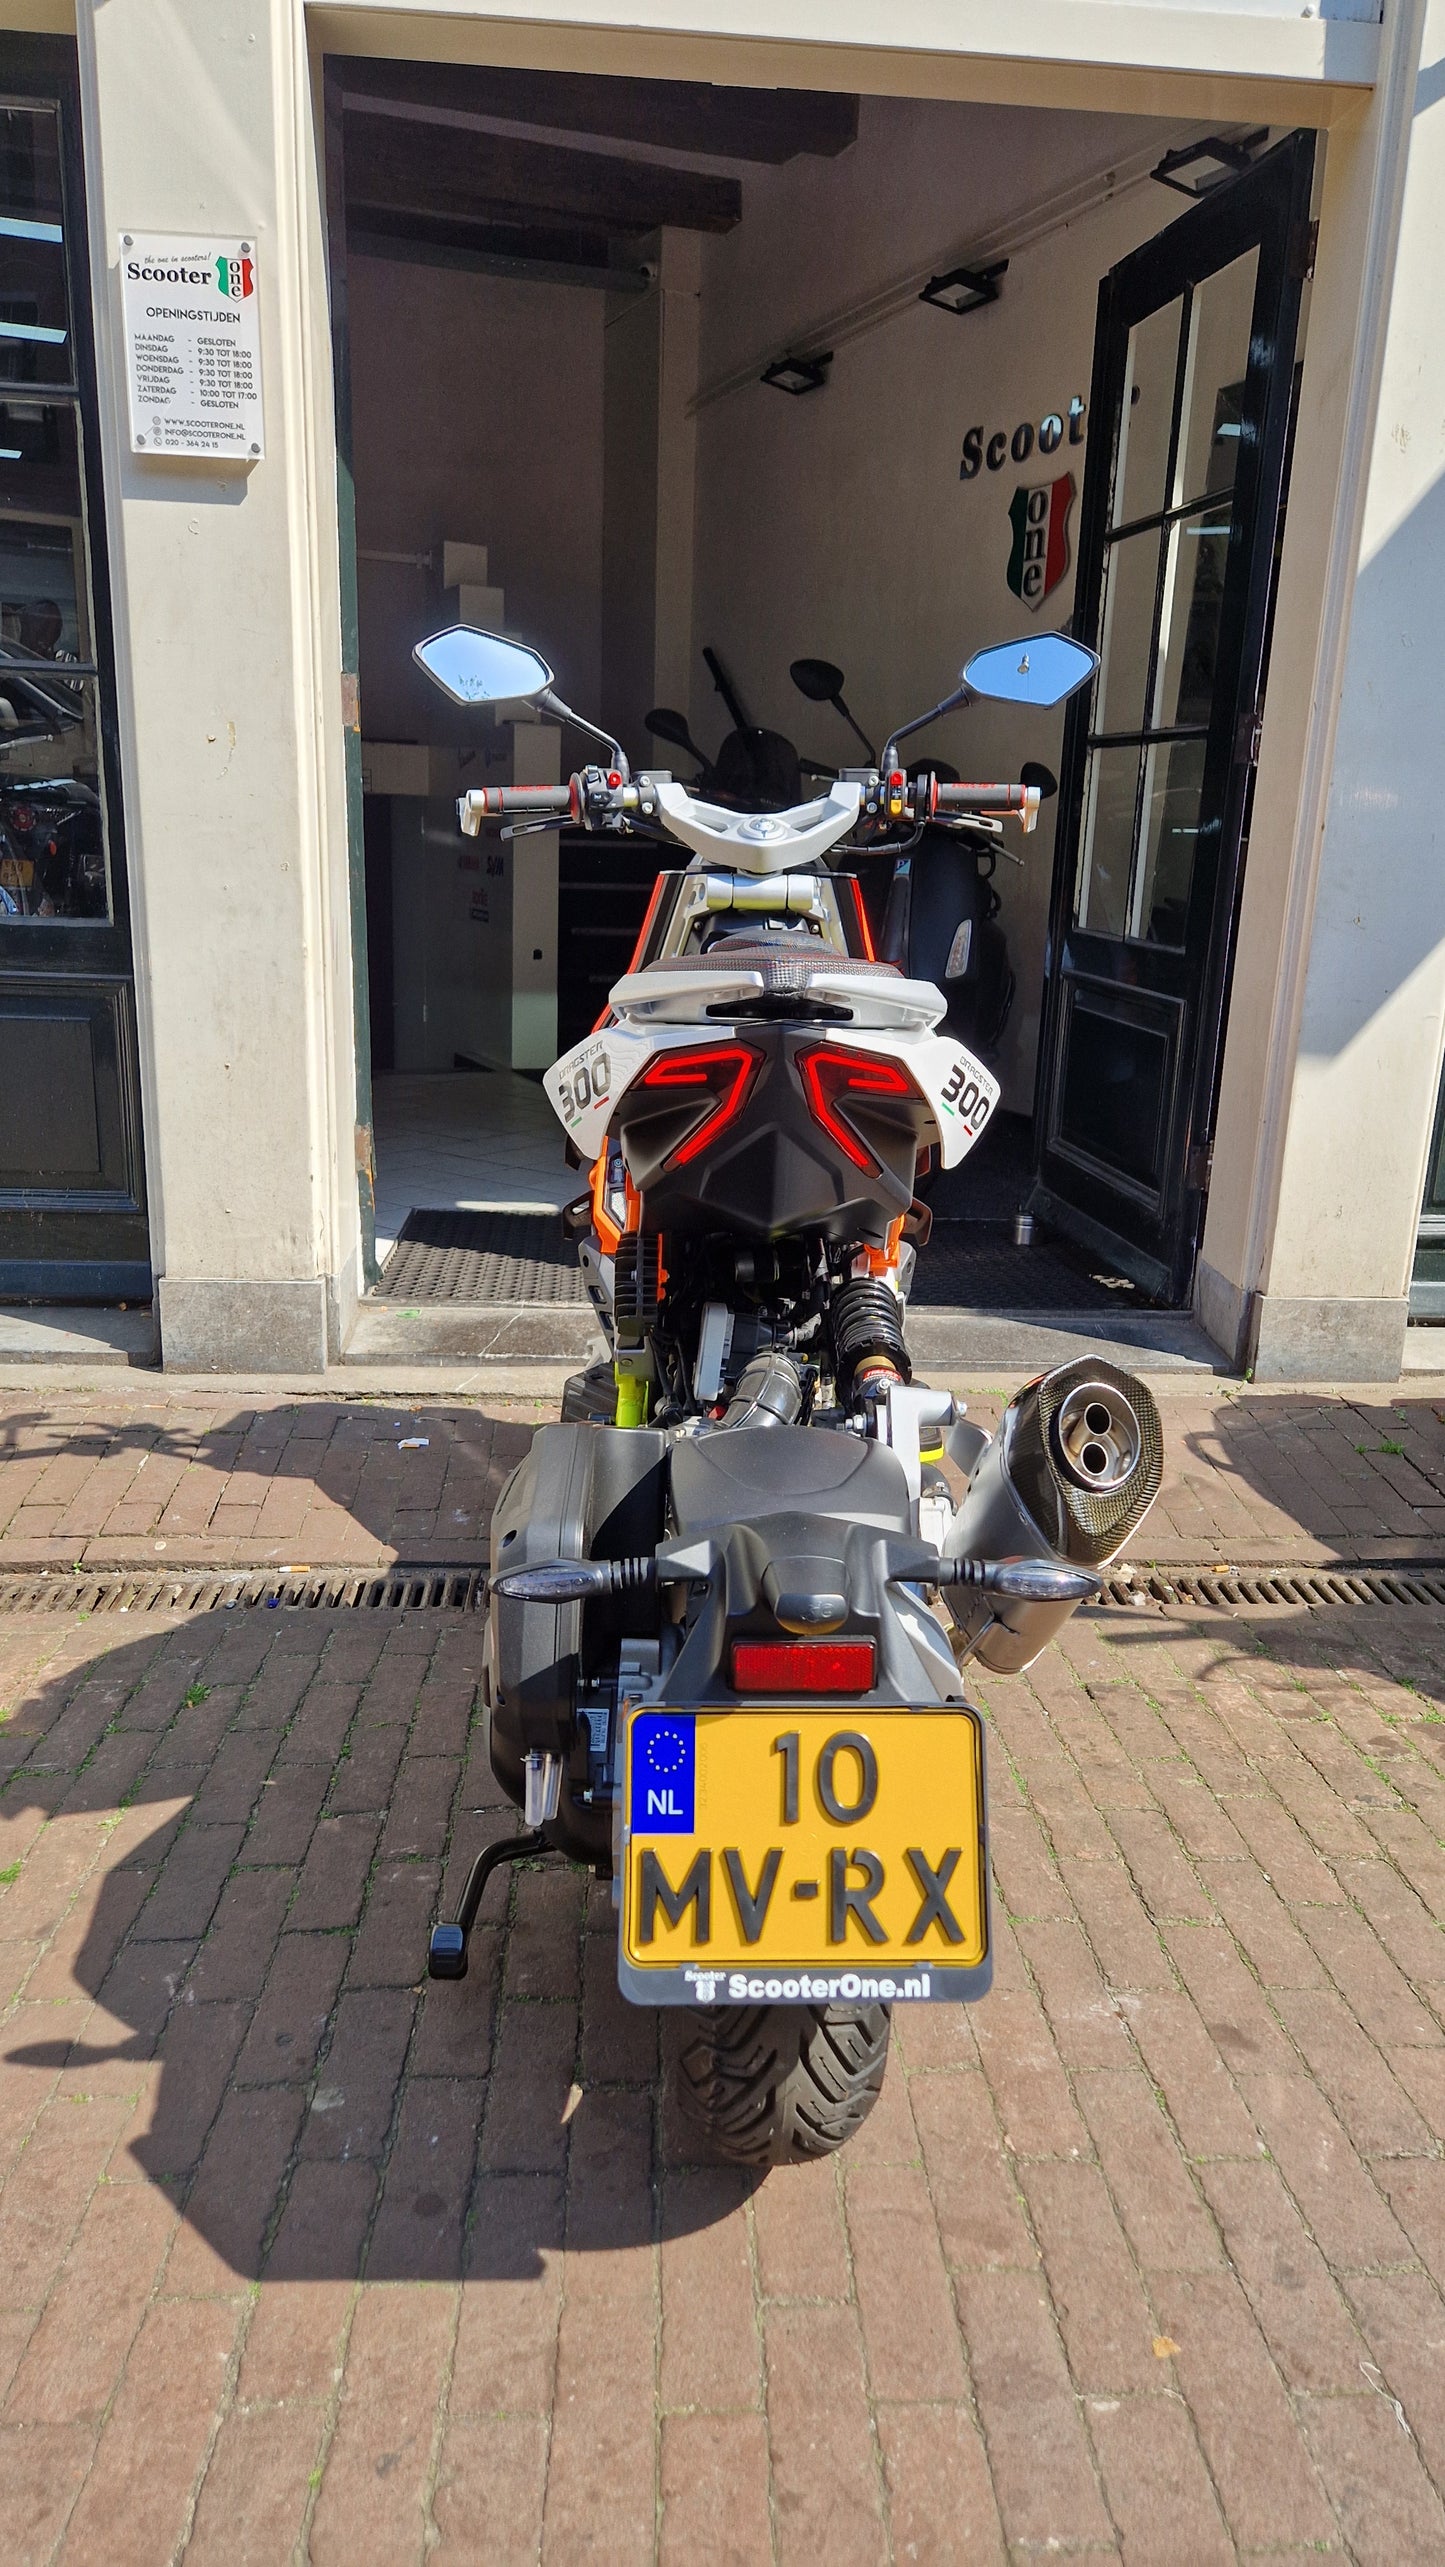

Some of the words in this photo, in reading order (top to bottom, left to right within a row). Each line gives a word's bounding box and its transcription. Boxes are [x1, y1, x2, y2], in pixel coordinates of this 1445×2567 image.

[128, 262, 212, 285] Scooter
[230, 262, 241, 298] one
[146, 306, 240, 322] OPENINGSTIJDEN
[134, 334, 175, 343] MAANDAG
[197, 337, 236, 347] GESLOTEN
[135, 343, 168, 352] DINSDAG
[198, 348, 214, 356] 9:30
[217, 349, 231, 357] TOT
[232, 350, 252, 358] 18:00
[136, 354, 180, 364] WOENSDAG
[198, 358, 215, 366] 9:30
[218, 360, 231, 368] TOT
[233, 360, 252, 369] 18:00
[136, 364, 184, 374] DONDERDAG
[199, 368, 216, 377] 9:30
[218, 370, 232, 378] TOT
[234, 371, 253, 380] 18:00
[137, 374, 170, 384] VRIJDAG
[200, 379, 216, 387] 9:30
[218, 380, 232, 388] TOT
[234, 381, 254, 390] 18:00
[138, 385, 177, 394] ZATERDAG
[200, 389, 220, 398] 10:00
[222, 390, 236, 398] TOT
[238, 392, 258, 400] 17:00
[138, 395, 171, 404] ZONDAG
[200, 400, 239, 408] GESLOTEN
[164, 418, 246, 430] WWW.SCOOTERONE.NL
[164, 428, 246, 440] INFO@SCOOTERONE.NL
[165, 438, 179, 446] 020
[960, 395, 1086, 480] Scoot
[1024, 490, 1048, 597] one
[559, 1040, 604, 1080] DRAGSTER
[558, 1052, 612, 1123] 300
[960, 1056, 994, 1096] DRAGSTER
[940, 1064, 990, 1130] 300
[774, 1730, 879, 1823] 10
[647, 1789, 684, 1815] NL
[638, 1847, 966, 1944] MV-RX
[728, 1973, 930, 1999] ScooterOne.nl
